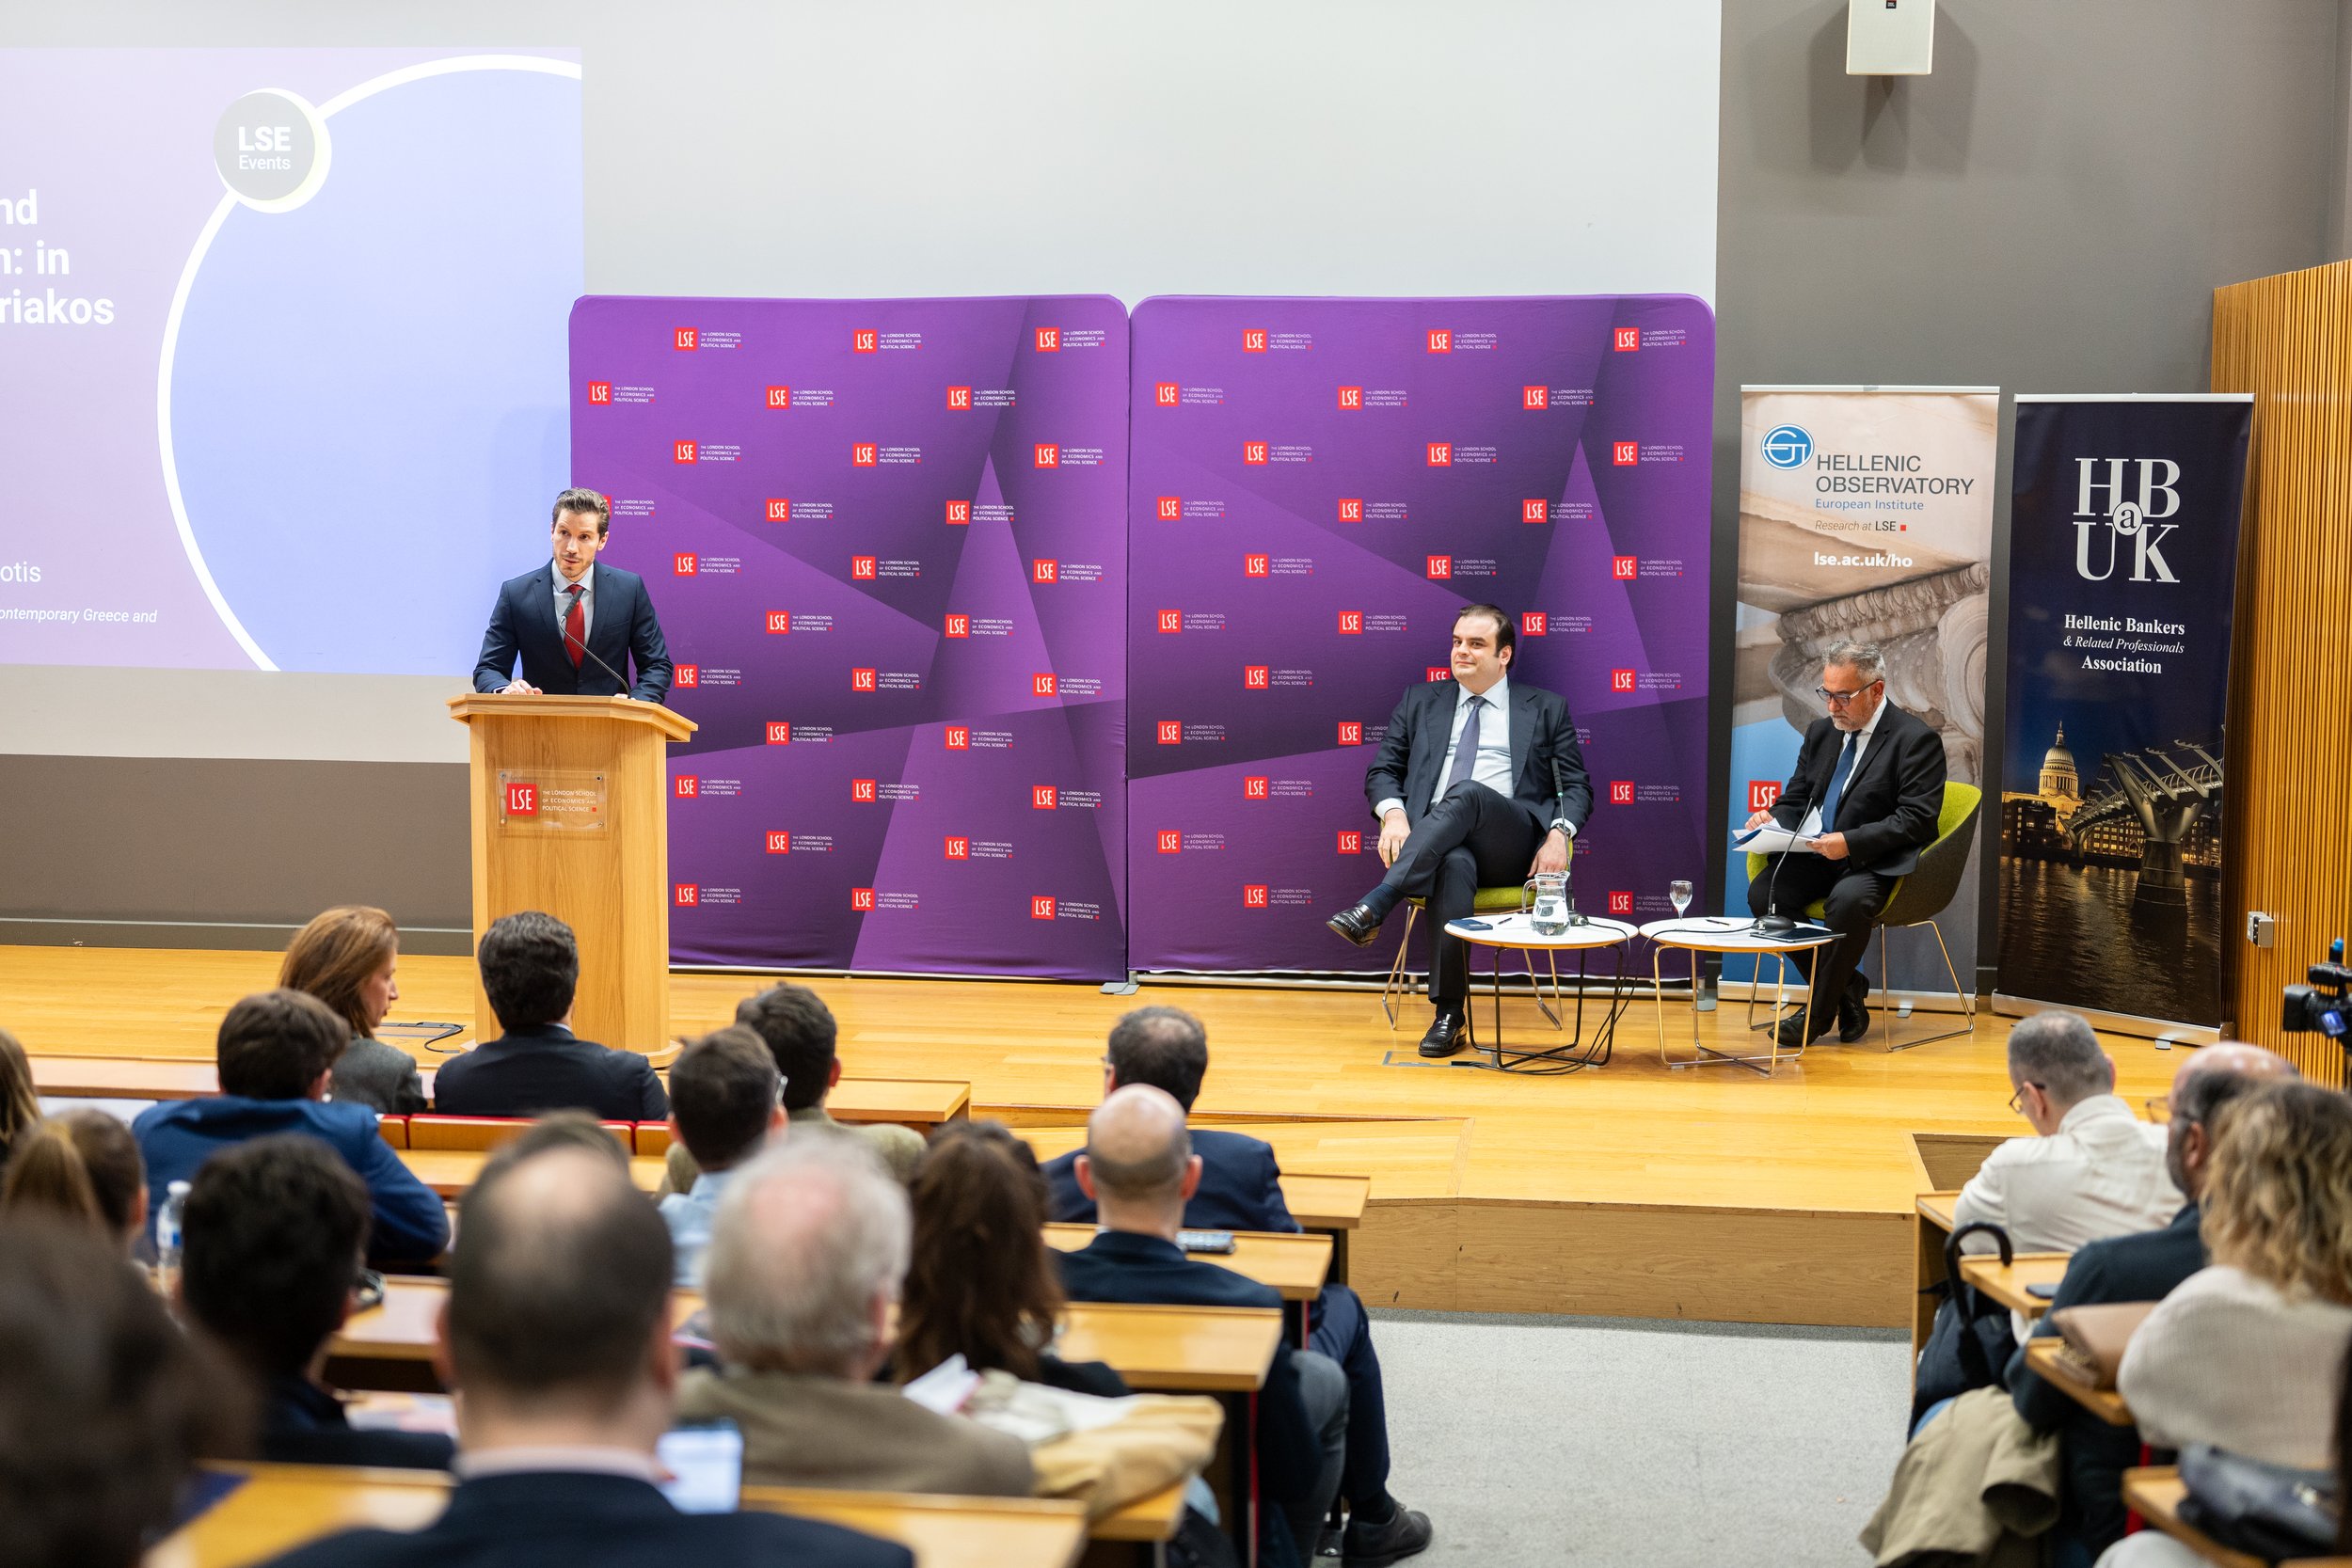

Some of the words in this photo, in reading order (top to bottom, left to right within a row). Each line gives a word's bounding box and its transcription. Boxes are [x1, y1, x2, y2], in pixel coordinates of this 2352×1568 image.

[238, 126, 292, 151] LSE
[239, 154, 292, 170] Events
[36, 239, 70, 275] in
[0, 287, 115, 325] riakos
[678, 331, 694, 347] LSE
[857, 333, 873, 350] LSE
[1040, 331, 1057, 348] LSE
[1247, 333, 1263, 349] LSE
[1431, 333, 1448, 350] LSE
[1618, 331, 1635, 348] LSE
[592, 385, 608, 402] LSE
[770, 389, 786, 405] LSE
[950, 390, 967, 406] LSE
[1159, 387, 1175, 403] LSE
[1342, 389, 1359, 406] LSE
[1527, 389, 1544, 405] LSE
[677, 444, 693, 460] LSE
[856, 447, 873, 463] LSE
[1039, 448, 1055, 465] LSE
[1248, 445, 1263, 462] LSE
[1431, 447, 1447, 463] LSE
[1617, 445, 1634, 462] LSE
[1816, 454, 1921, 472] HELLENIC
[1816, 476, 1975, 495] OBSERVATORY
[770, 502, 786, 518] LSE
[949, 504, 966, 521] LSE
[1161, 500, 1177, 516] LSE
[1343, 502, 1359, 518] LSE
[1527, 503, 1543, 519] LSE
[1816, 499, 1871, 512] European
[1875, 499, 1924, 511] Institute
[1815, 520, 1860, 531] Research
[1861, 521, 1872, 531] at
[1875, 520, 1897, 531] LSE
[677, 557, 693, 573] LSE
[1248, 558, 1264, 574] LSE
[1814, 551, 1913, 567] lse.ac.uk/ho
[0, 561, 41, 583] otis
[856, 560, 872, 576] LSE
[1037, 563, 1054, 579] LSE
[1431, 560, 1447, 575] LSE
[1616, 560, 1633, 576] LSE
[83, 608, 130, 623] Greece
[132, 609, 158, 623] and
[770, 614, 786, 630] LSE
[1162, 613, 1178, 629] LSE
[1343, 614, 1359, 630] LSE
[949, 618, 965, 634] LSE
[1526, 616, 1542, 632] LSE
[2064, 614, 2122, 631] Hellenic
[2125, 617, 2185, 635] Bankers
[2063, 635, 2073, 646] &
[2074, 636, 2114, 649] Related
[2116, 638, 2185, 654] Professionals
[2081, 655, 2162, 674] Association
[678, 668, 694, 684] LSE
[856, 672, 872, 688] LSE
[1248, 670, 1264, 686] LSE
[1615, 673, 1631, 689] LSE
[1037, 677, 1053, 693] LSE
[770, 725, 786, 741] LSE
[949, 730, 964, 746] LSE
[1162, 725, 1177, 740] LSE
[1342, 725, 1358, 741] LSE
[678, 779, 694, 795] LSE
[856, 783, 872, 799] LSE
[1248, 780, 1264, 796] LSE
[1614, 785, 1630, 800] LSE
[511, 788, 532, 811] LSE
[1037, 789, 1053, 805] LSE
[770, 834, 786, 850] LSE
[948, 840, 964, 856] LSE
[1161, 834, 1177, 849] LSE
[1342, 835, 1357, 850] LSE
[678, 887, 694, 903] LSE
[855, 892, 871, 908] LSE
[1248, 889, 1263, 904] LSE
[1613, 895, 1629, 911] LSE
[1035, 900, 1052, 916] LSE
